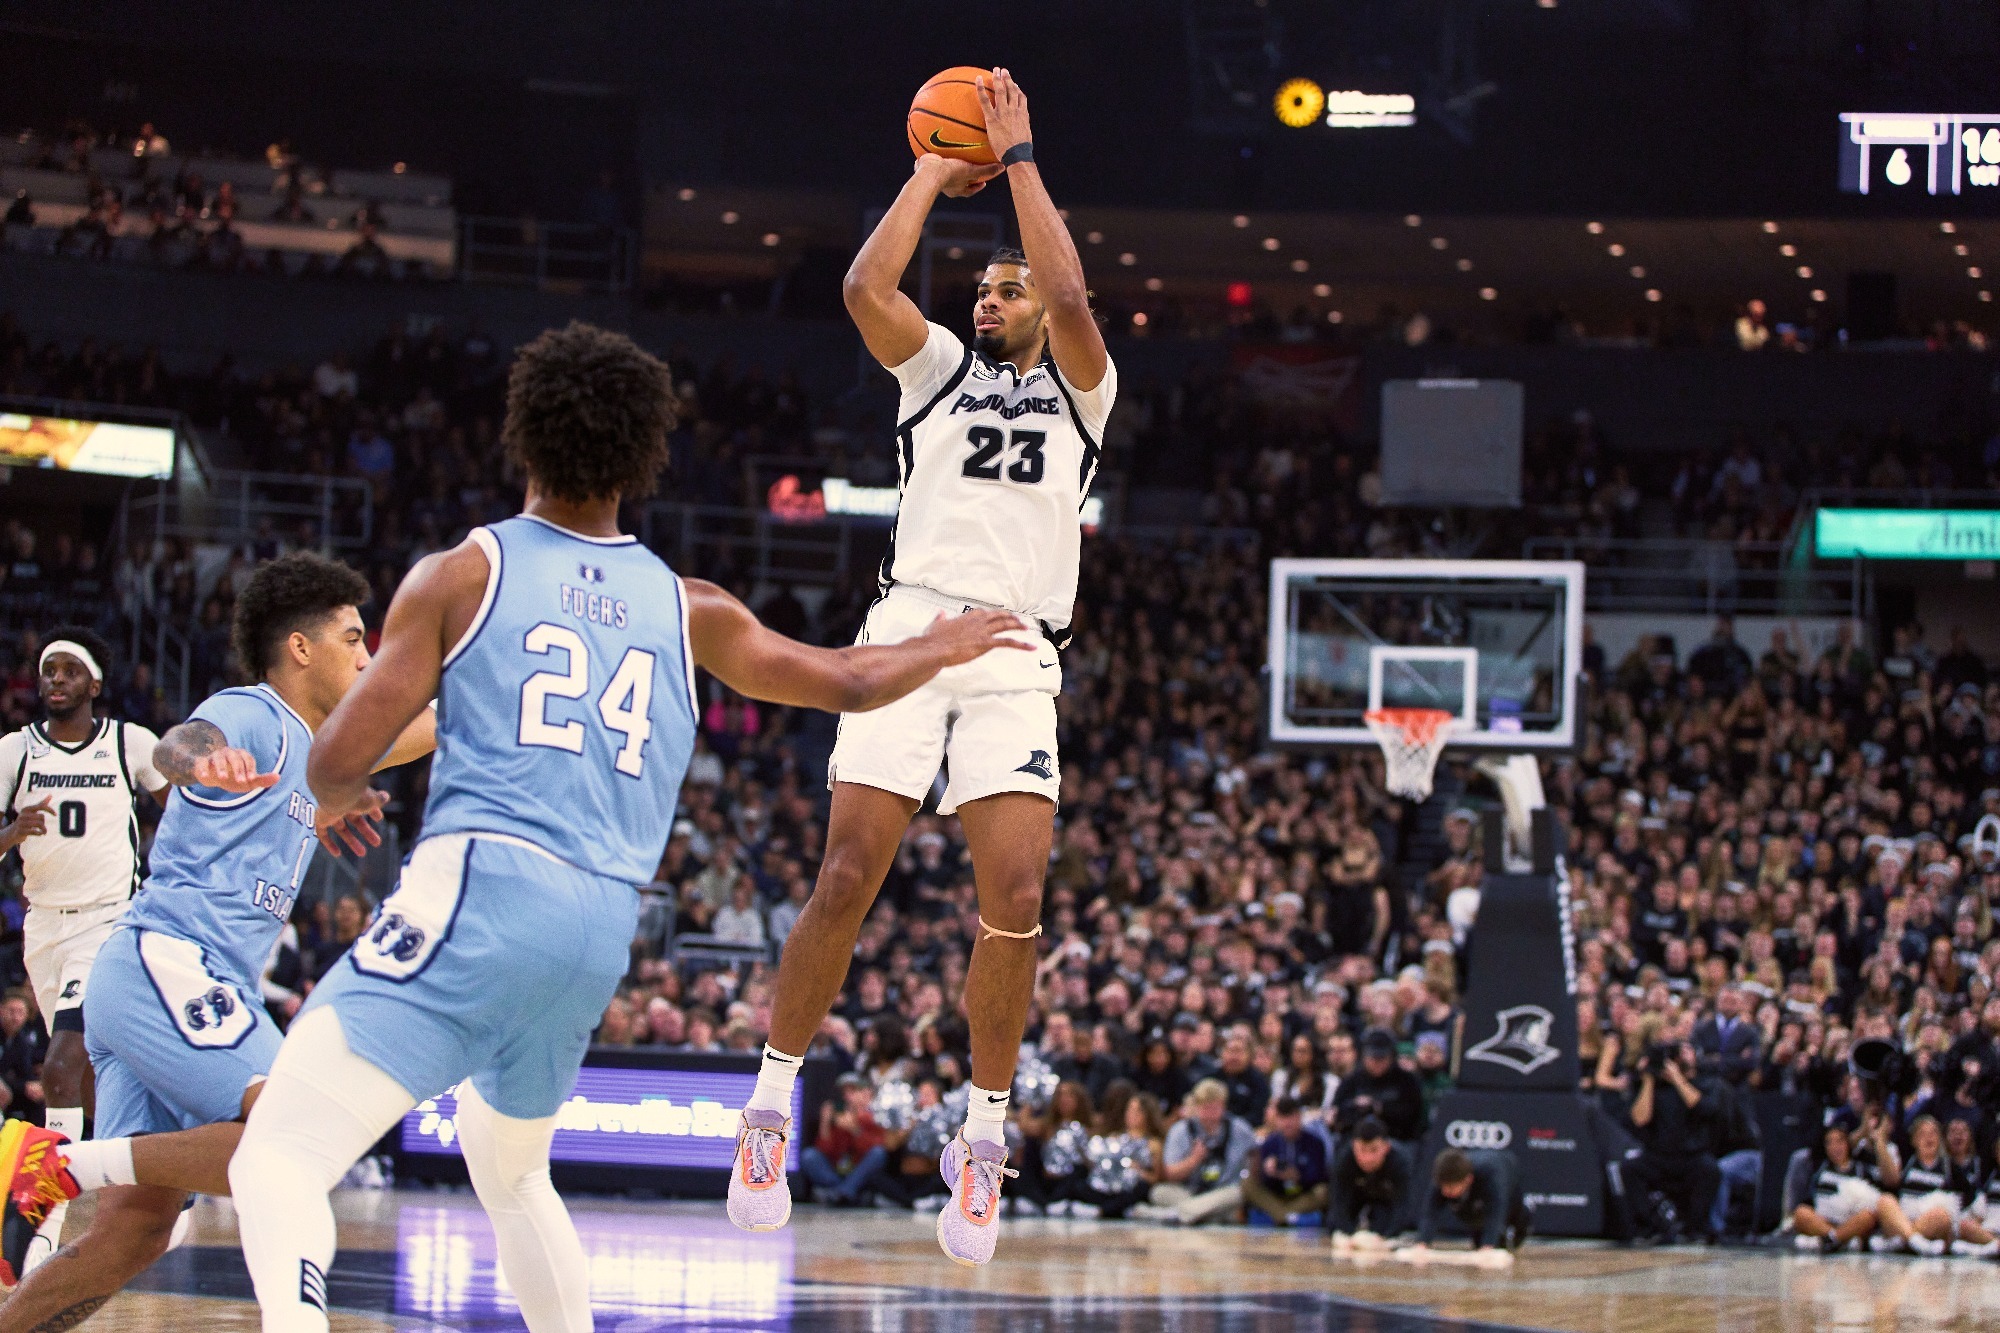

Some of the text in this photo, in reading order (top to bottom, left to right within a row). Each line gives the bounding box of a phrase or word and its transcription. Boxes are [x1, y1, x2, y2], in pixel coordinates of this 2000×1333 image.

[1886, 148, 1911, 185] 6
[948, 392, 1061, 420] PROVIDENCE
[961, 424, 1047, 485] 23
[561, 584, 628, 630] FUCHS
[517, 621, 656, 780] 24
[27, 771, 117, 793] PROVIDENCE
[59, 800, 87, 838] 0
[287, 790, 317, 832] RHO
[290, 836, 310, 890] 1
